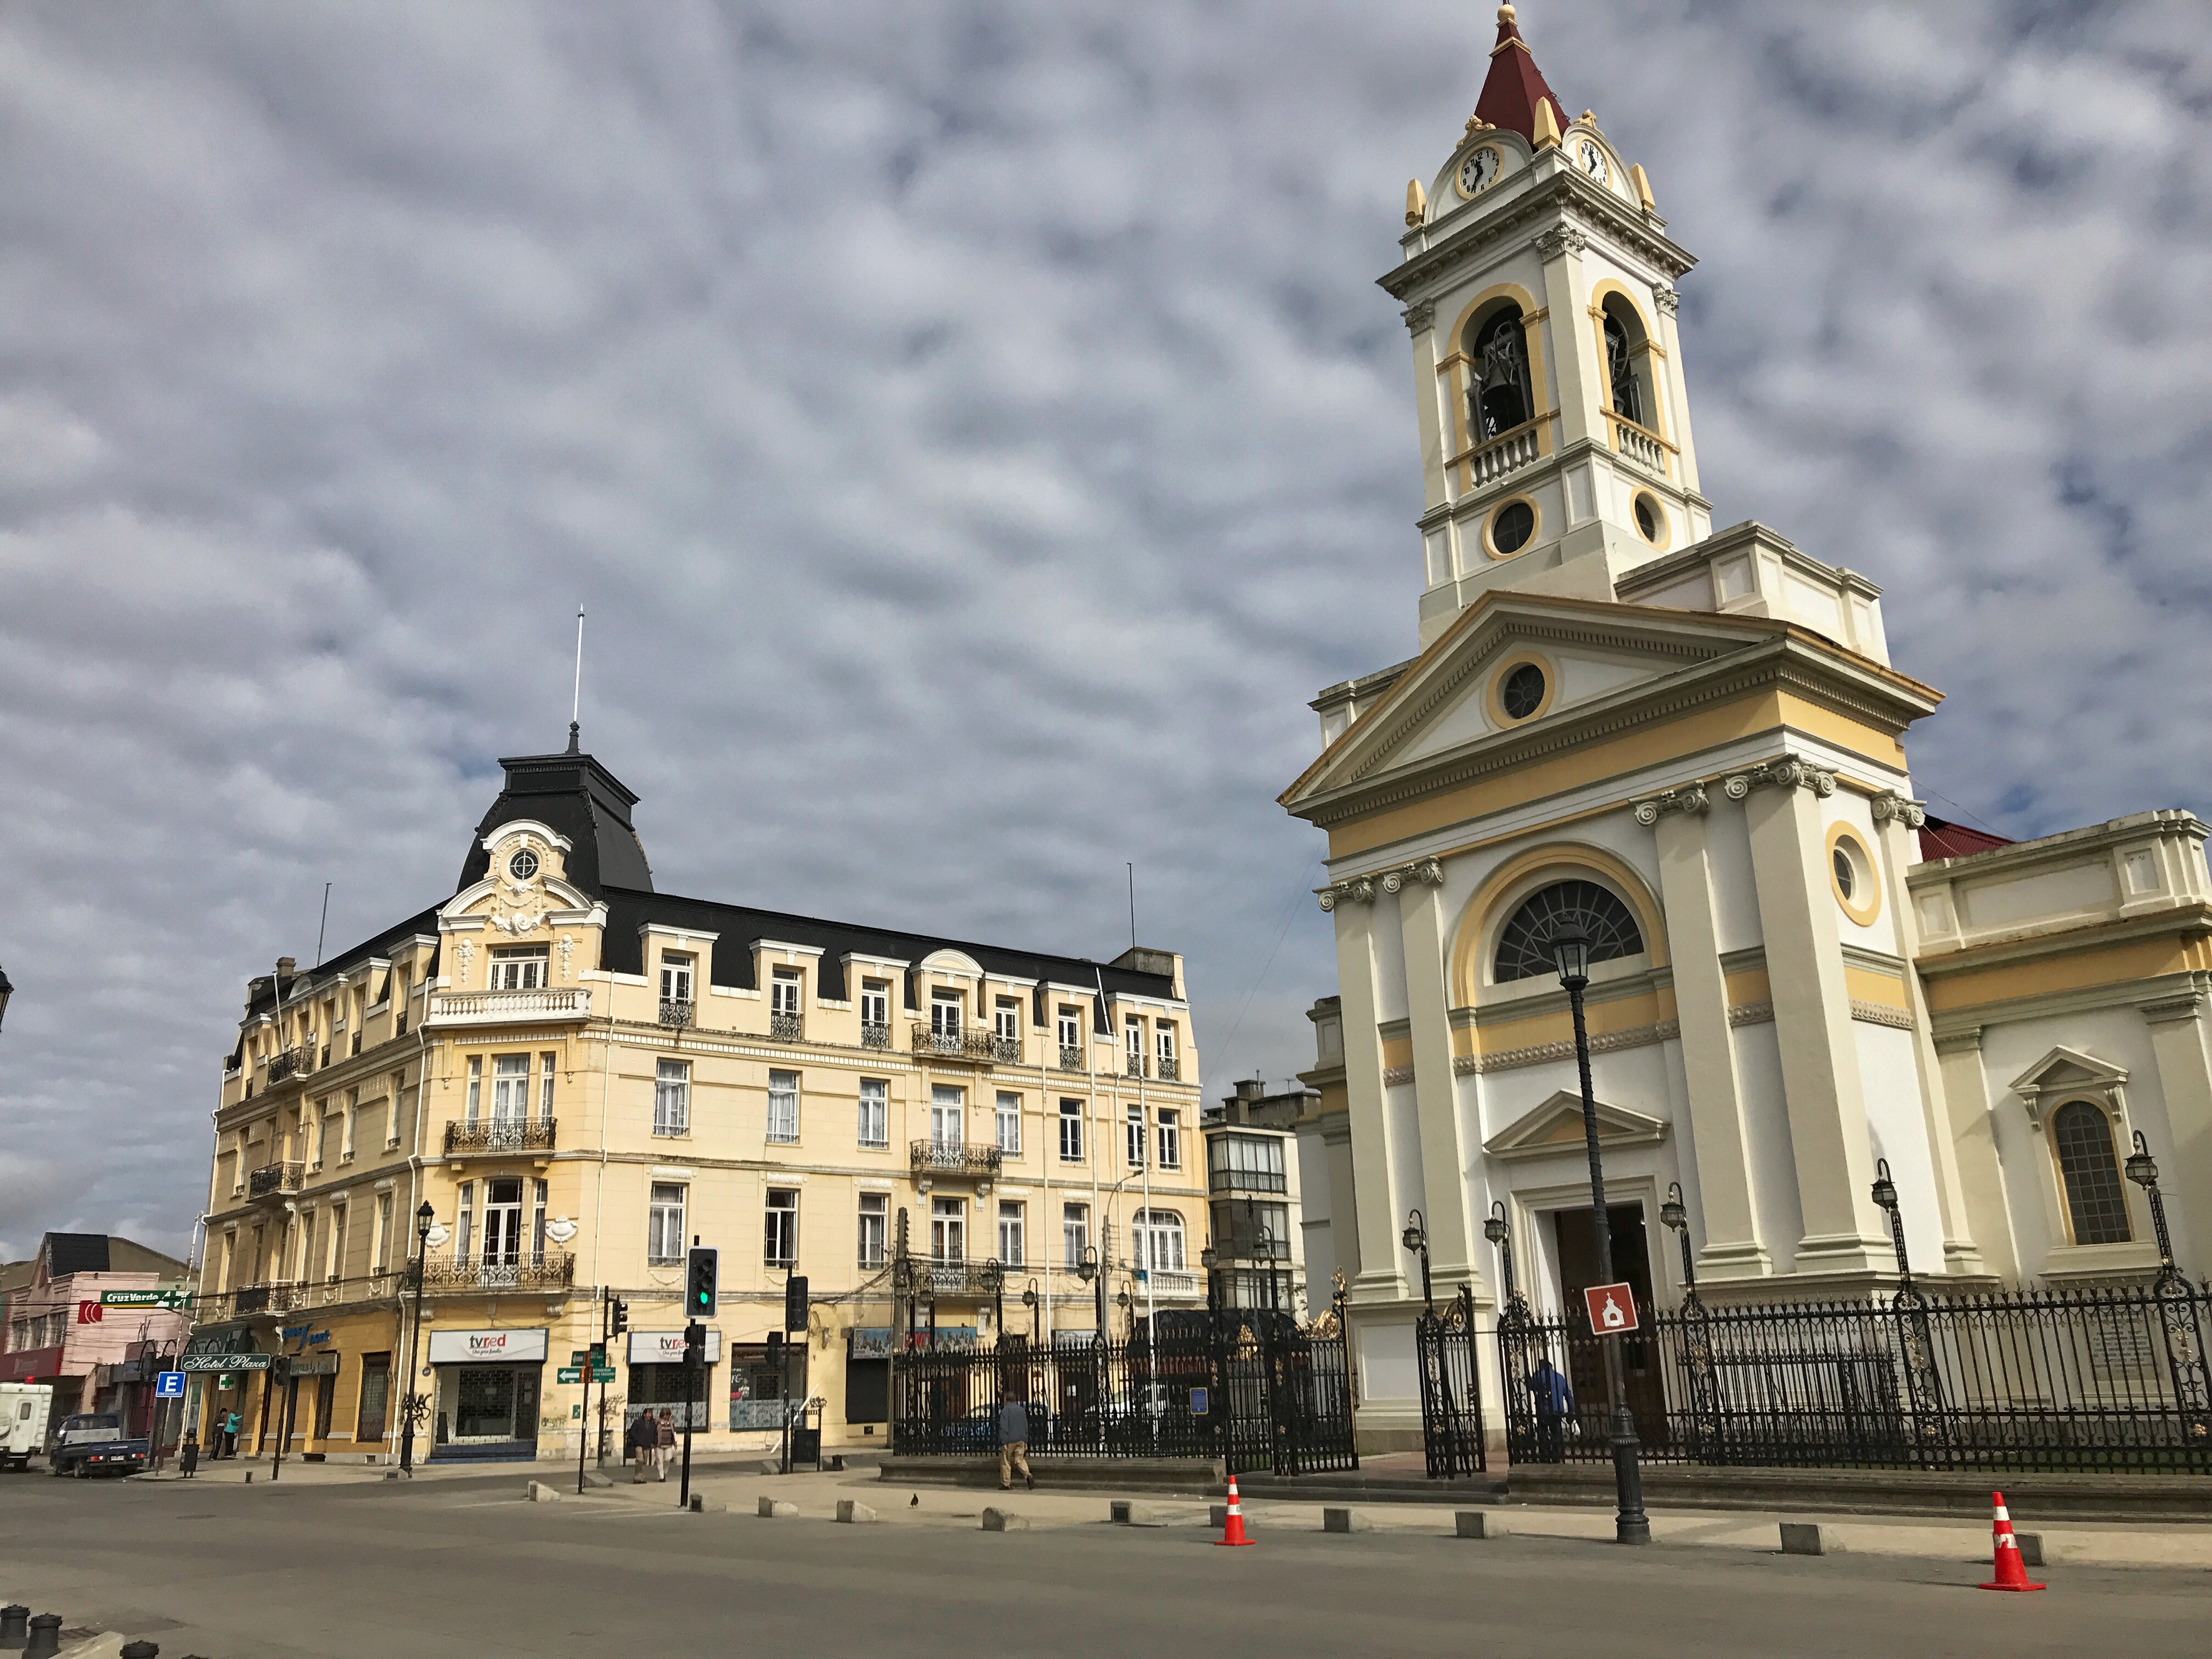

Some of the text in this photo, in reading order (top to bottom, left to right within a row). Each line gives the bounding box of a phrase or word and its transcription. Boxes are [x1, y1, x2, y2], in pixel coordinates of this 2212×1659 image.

[1477, 152, 1483, 160] 12
[1486, 150, 1489, 158] 1
[1464, 167, 1470, 175] 10
[470, 1334, 506, 1348] tvred
[184, 1355, 267, 1369] Hotel Plaza
[165, 1376, 178, 1392] E
